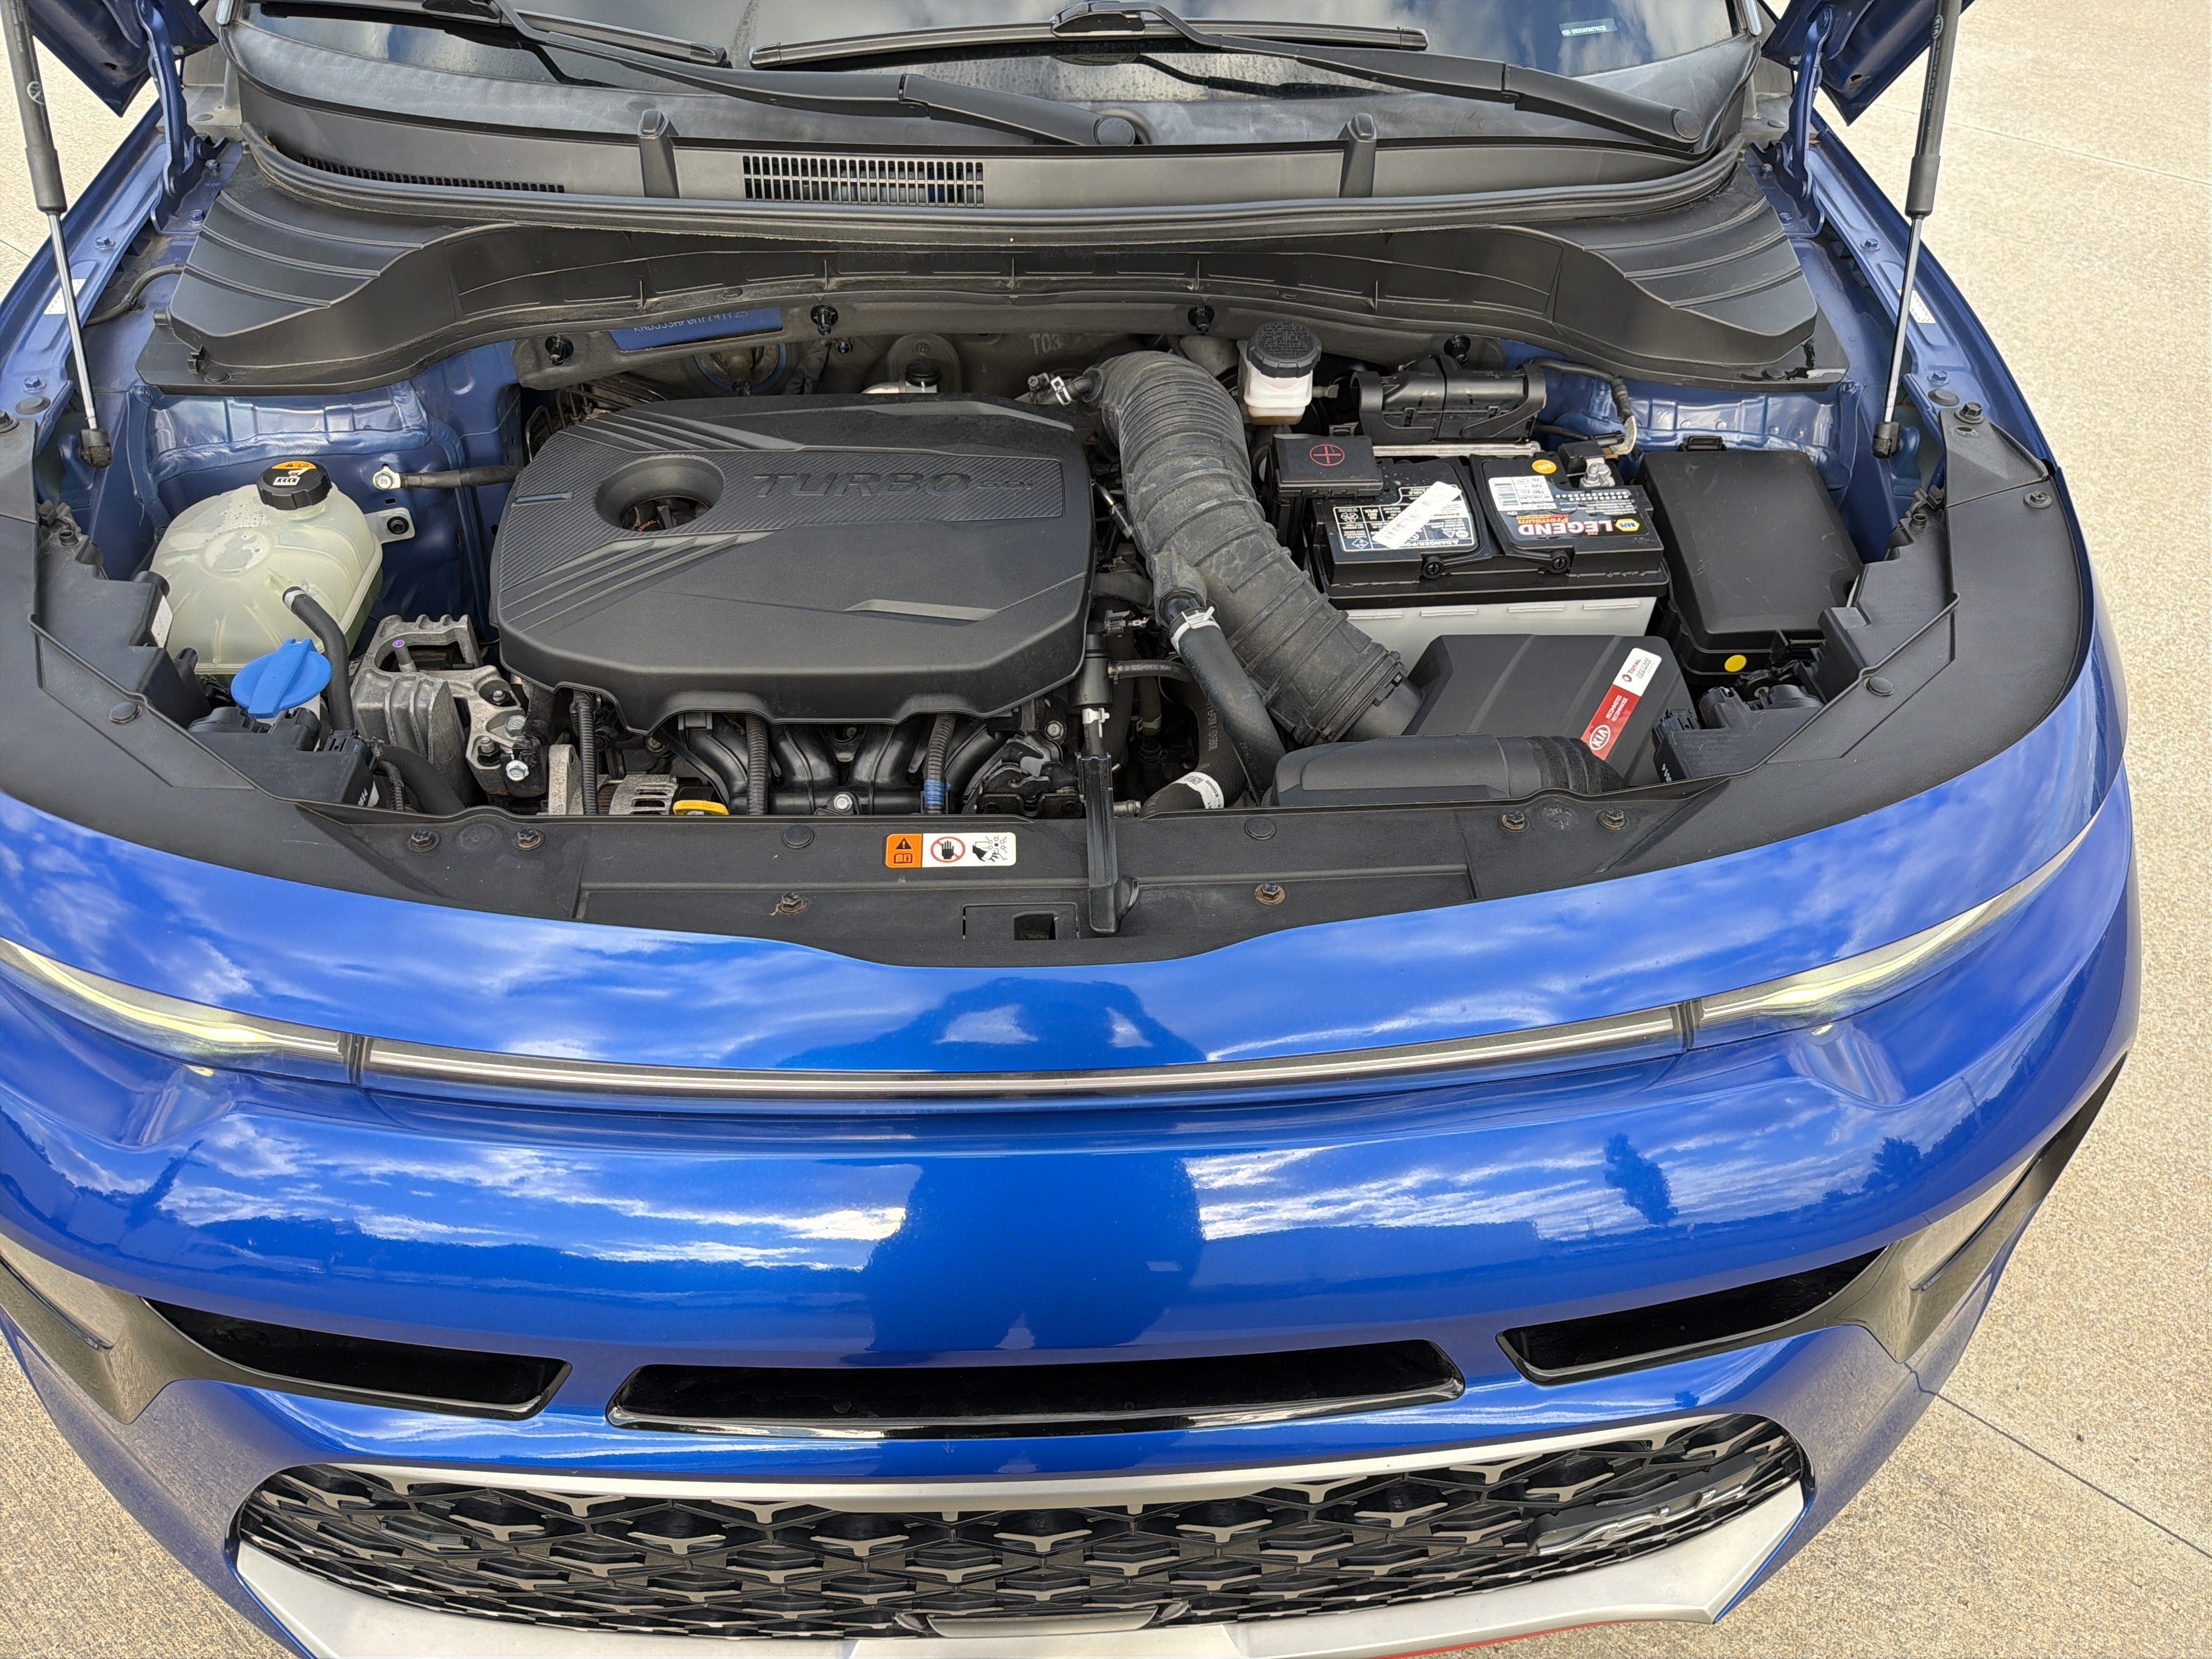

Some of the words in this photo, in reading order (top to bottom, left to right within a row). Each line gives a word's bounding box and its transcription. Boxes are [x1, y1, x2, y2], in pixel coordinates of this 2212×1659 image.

[753, 472, 971, 498] TURBO
[1518, 520, 1613, 535] LEGEND
[1627, 658, 1641, 674] TOTAL
[1591, 729, 1609, 747] KIA
